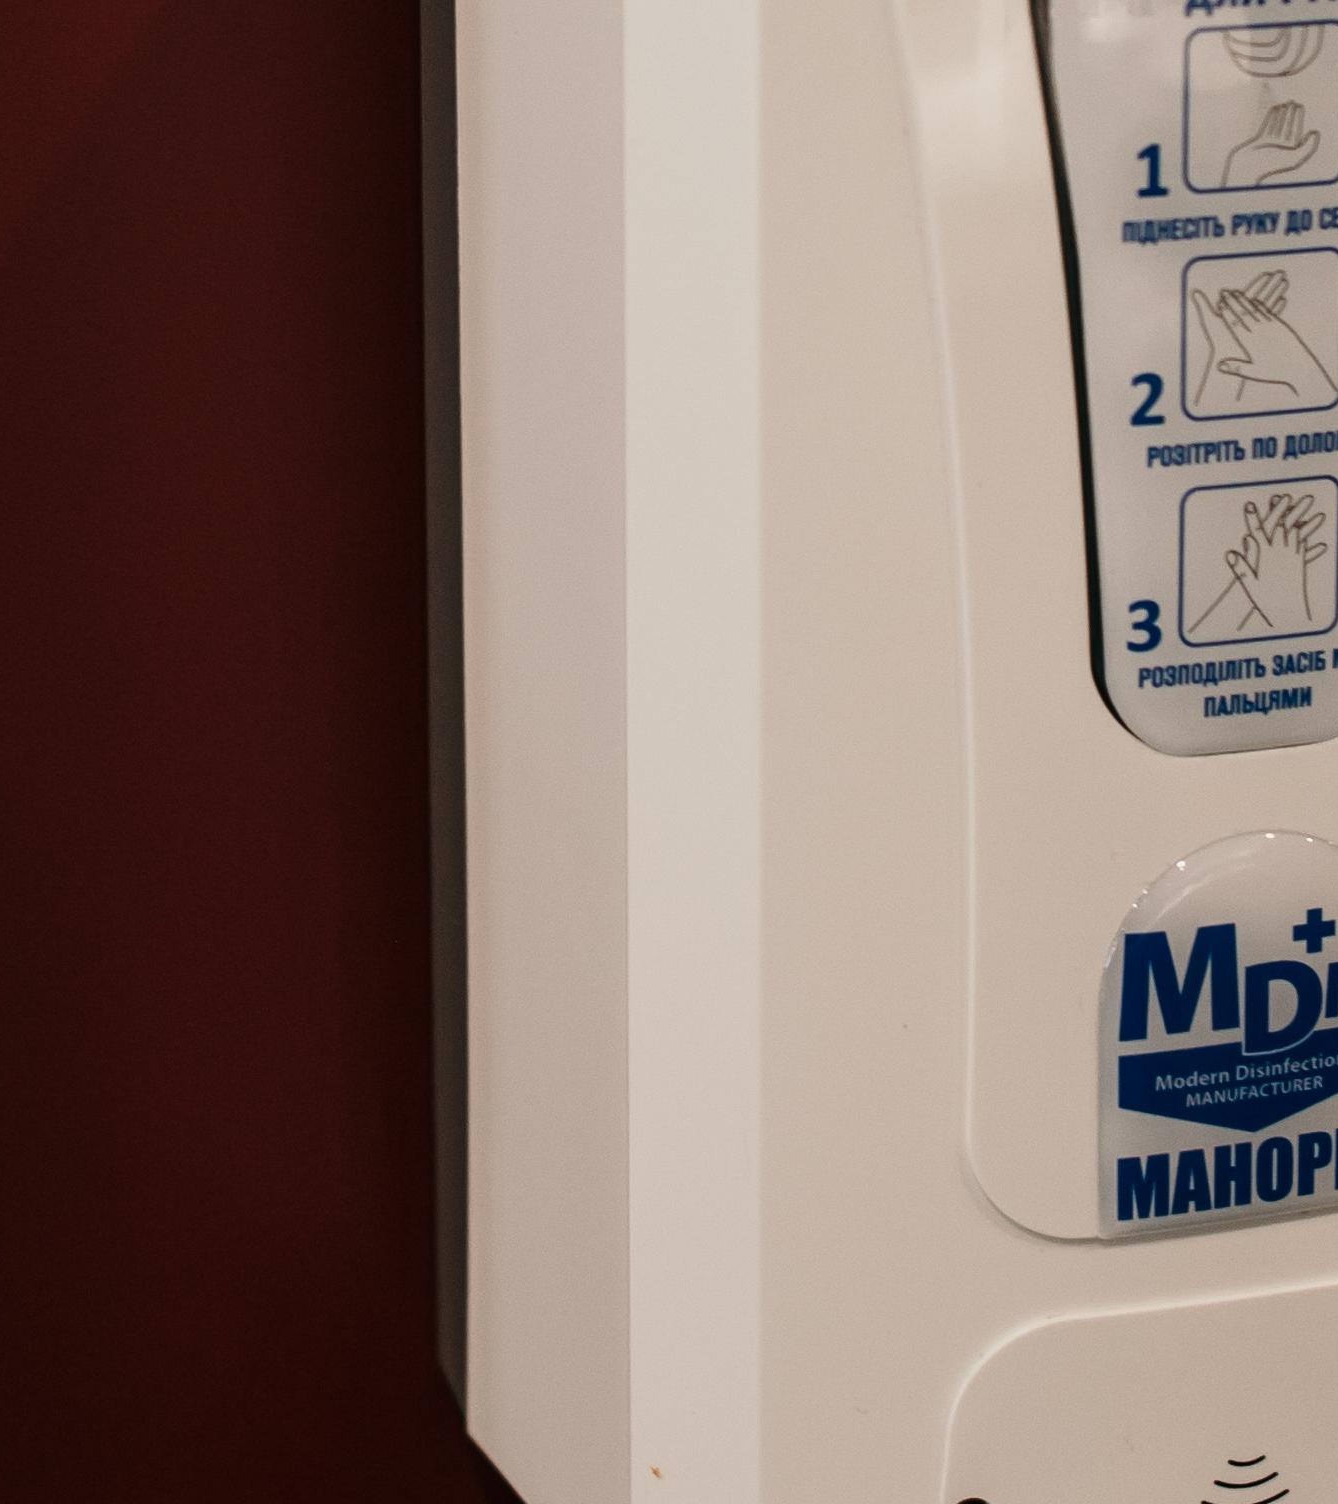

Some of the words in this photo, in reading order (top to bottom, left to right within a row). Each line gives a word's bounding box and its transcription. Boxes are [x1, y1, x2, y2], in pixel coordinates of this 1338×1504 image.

[1136, 143, 1170, 198] 1
[1122, 214, 1225, 245] ПІДНЕСІТЬ
[1231, 210, 1281, 237] РУКУ
[1284, 208, 1313, 236] ДО
[1129, 372, 1166, 426] 2
[1146, 439, 1246, 468] РОЗІТРІТЬ
[1251, 435, 1278, 461] ПО
[1125, 599, 1162, 652] 3
[1138, 660, 1267, 689] РОЗПОДІЛІТЬ
[1272, 651, 1327, 676] ЗАСІБ
[1203, 686, 1313, 718] ПАЛЬЦЯМИ
[1155, 1069, 1231, 1093] Modern
[1185, 1074, 1324, 1108] MANUFACTURER
